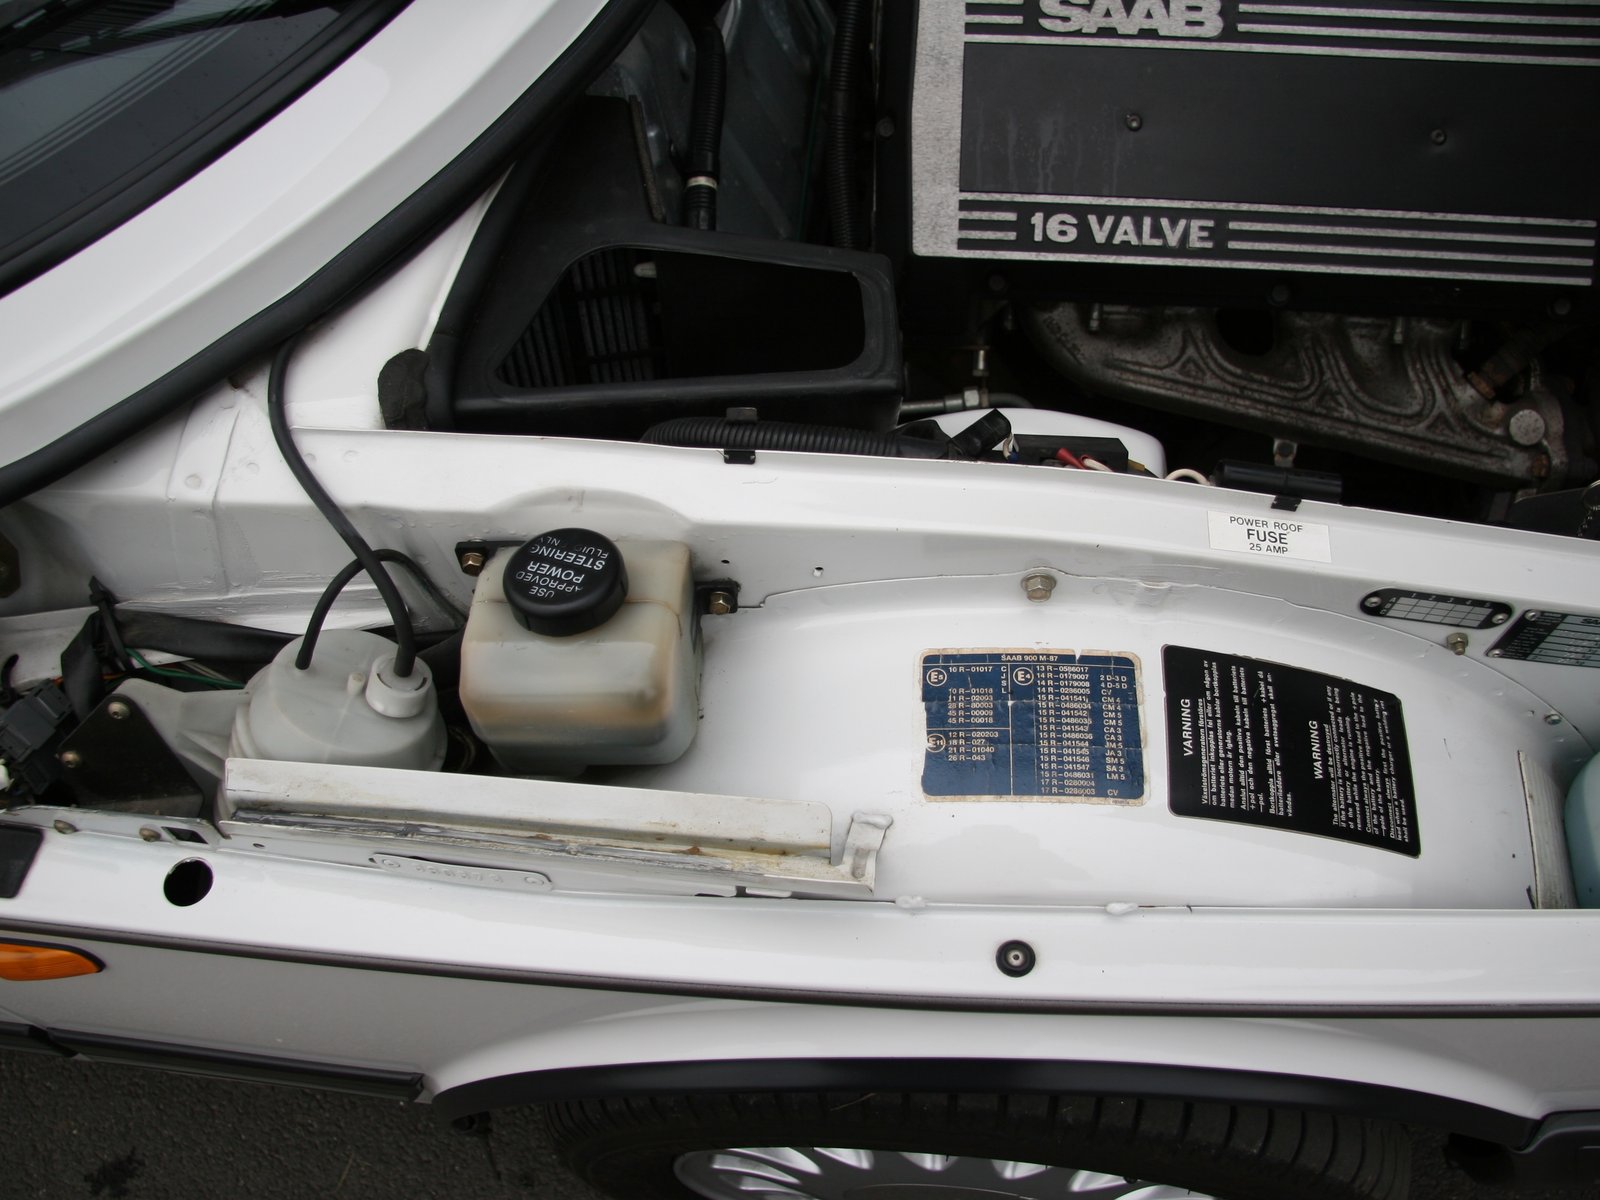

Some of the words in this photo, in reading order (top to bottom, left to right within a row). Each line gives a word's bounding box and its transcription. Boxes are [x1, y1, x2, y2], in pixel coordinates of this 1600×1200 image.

[1038, 0, 1223, 38] SAAB
[1030, 212, 1078, 243] 16
[1087, 214, 1215, 249] VALVE
[1230, 516, 1269, 528] POWER
[1273, 521, 1303, 533] ROOF
[1247, 528, 1288, 545] FUSE
[530, 544, 605, 570] STEERING
[575, 546, 609, 559] FLUI
[1249, 542, 1262, 552] 25
[1266, 545, 1288, 554] AMP
[515, 571, 584, 592] APPROVED
[527, 561, 585, 583] POWER
[529, 586, 555, 598] USE
[1206, 690, 1211, 701] om
[1180, 699, 1193, 756] VARNING
[1216, 719, 1225, 758] generatorns
[1323, 723, 1332, 755] destroyed
[1328, 710, 1338, 743] connected
[1208, 731, 1216, 762] inkopplas
[1236, 728, 1245, 753] positiva
[1244, 732, 1253, 760] negativa
[1308, 720, 1324, 779] WARNING
[1327, 756, 1333, 765] be
[1358, 745, 1366, 770] positive
[1211, 795, 1217, 805] om
[1362, 782, 1370, 804] always
[1364, 805, 1372, 833] Connect
